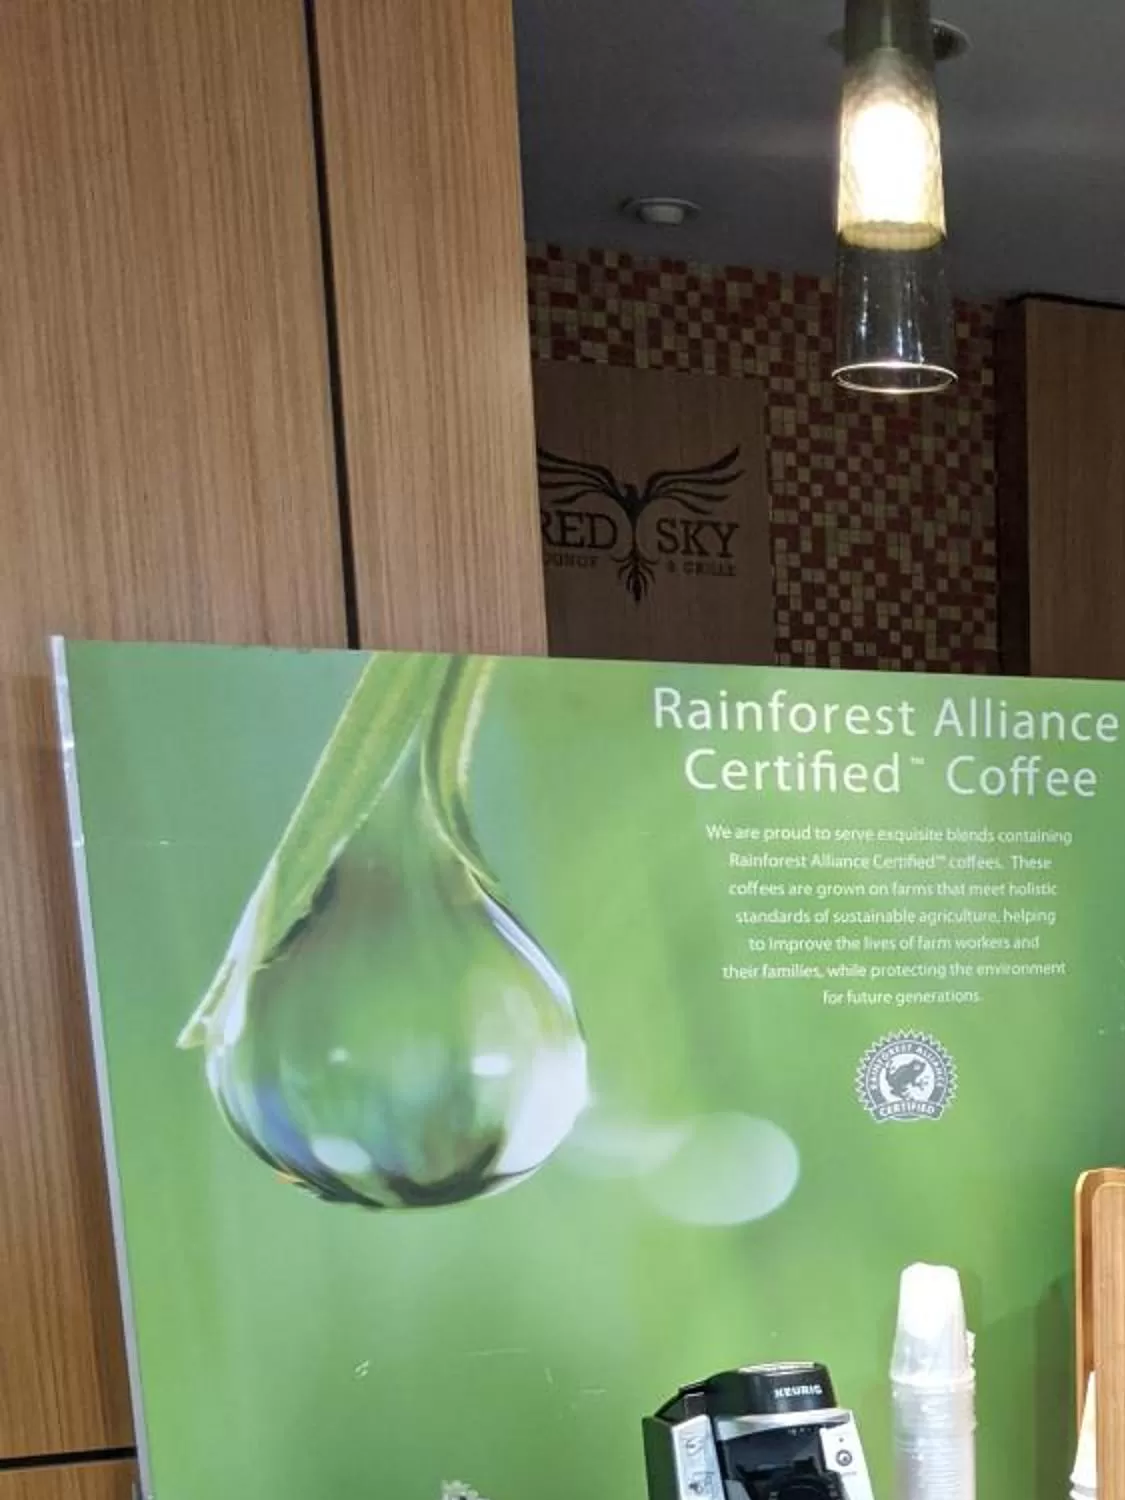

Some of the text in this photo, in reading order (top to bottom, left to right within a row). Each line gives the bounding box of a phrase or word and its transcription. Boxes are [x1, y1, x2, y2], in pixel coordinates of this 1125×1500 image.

[656, 516, 740, 558] SKY
[654, 687, 1119, 742] Rainforest Alliance
[946, 756, 1096, 797] Coffee
[705, 824, 732, 840] We
[734, 828, 760, 839] are
[763, 825, 811, 842] proud
[814, 828, 831, 840] to
[834, 829, 874, 841] serve
[946, 828, 994, 842] blends
[998, 829, 1072, 846] containing
[729, 852, 806, 868] Rainforest
[810, 854, 869, 869] Alliance
[1011, 855, 1052, 869] These
[728, 880, 1057, 899] coffees are grown on farms that meet holistic
[736, 908, 811, 924] standards
[814, 909, 829, 923] of
[833, 909, 916, 923] sustainable
[1004, 908, 1056, 925] helping
[748, 936, 1039, 953] to improve the lives of farm workers and
[722, 964, 763, 979] their
[827, 964, 867, 977] while
[870, 965, 947, 979] protecting
[950, 963, 973, 976] the
[977, 962, 1066, 976] environment
[823, 990, 844, 1004] for
[847, 990, 892, 1005] future
[879, 1102, 935, 1117] CERTIFIED
[774, 1383, 823, 1399] KEURIG
